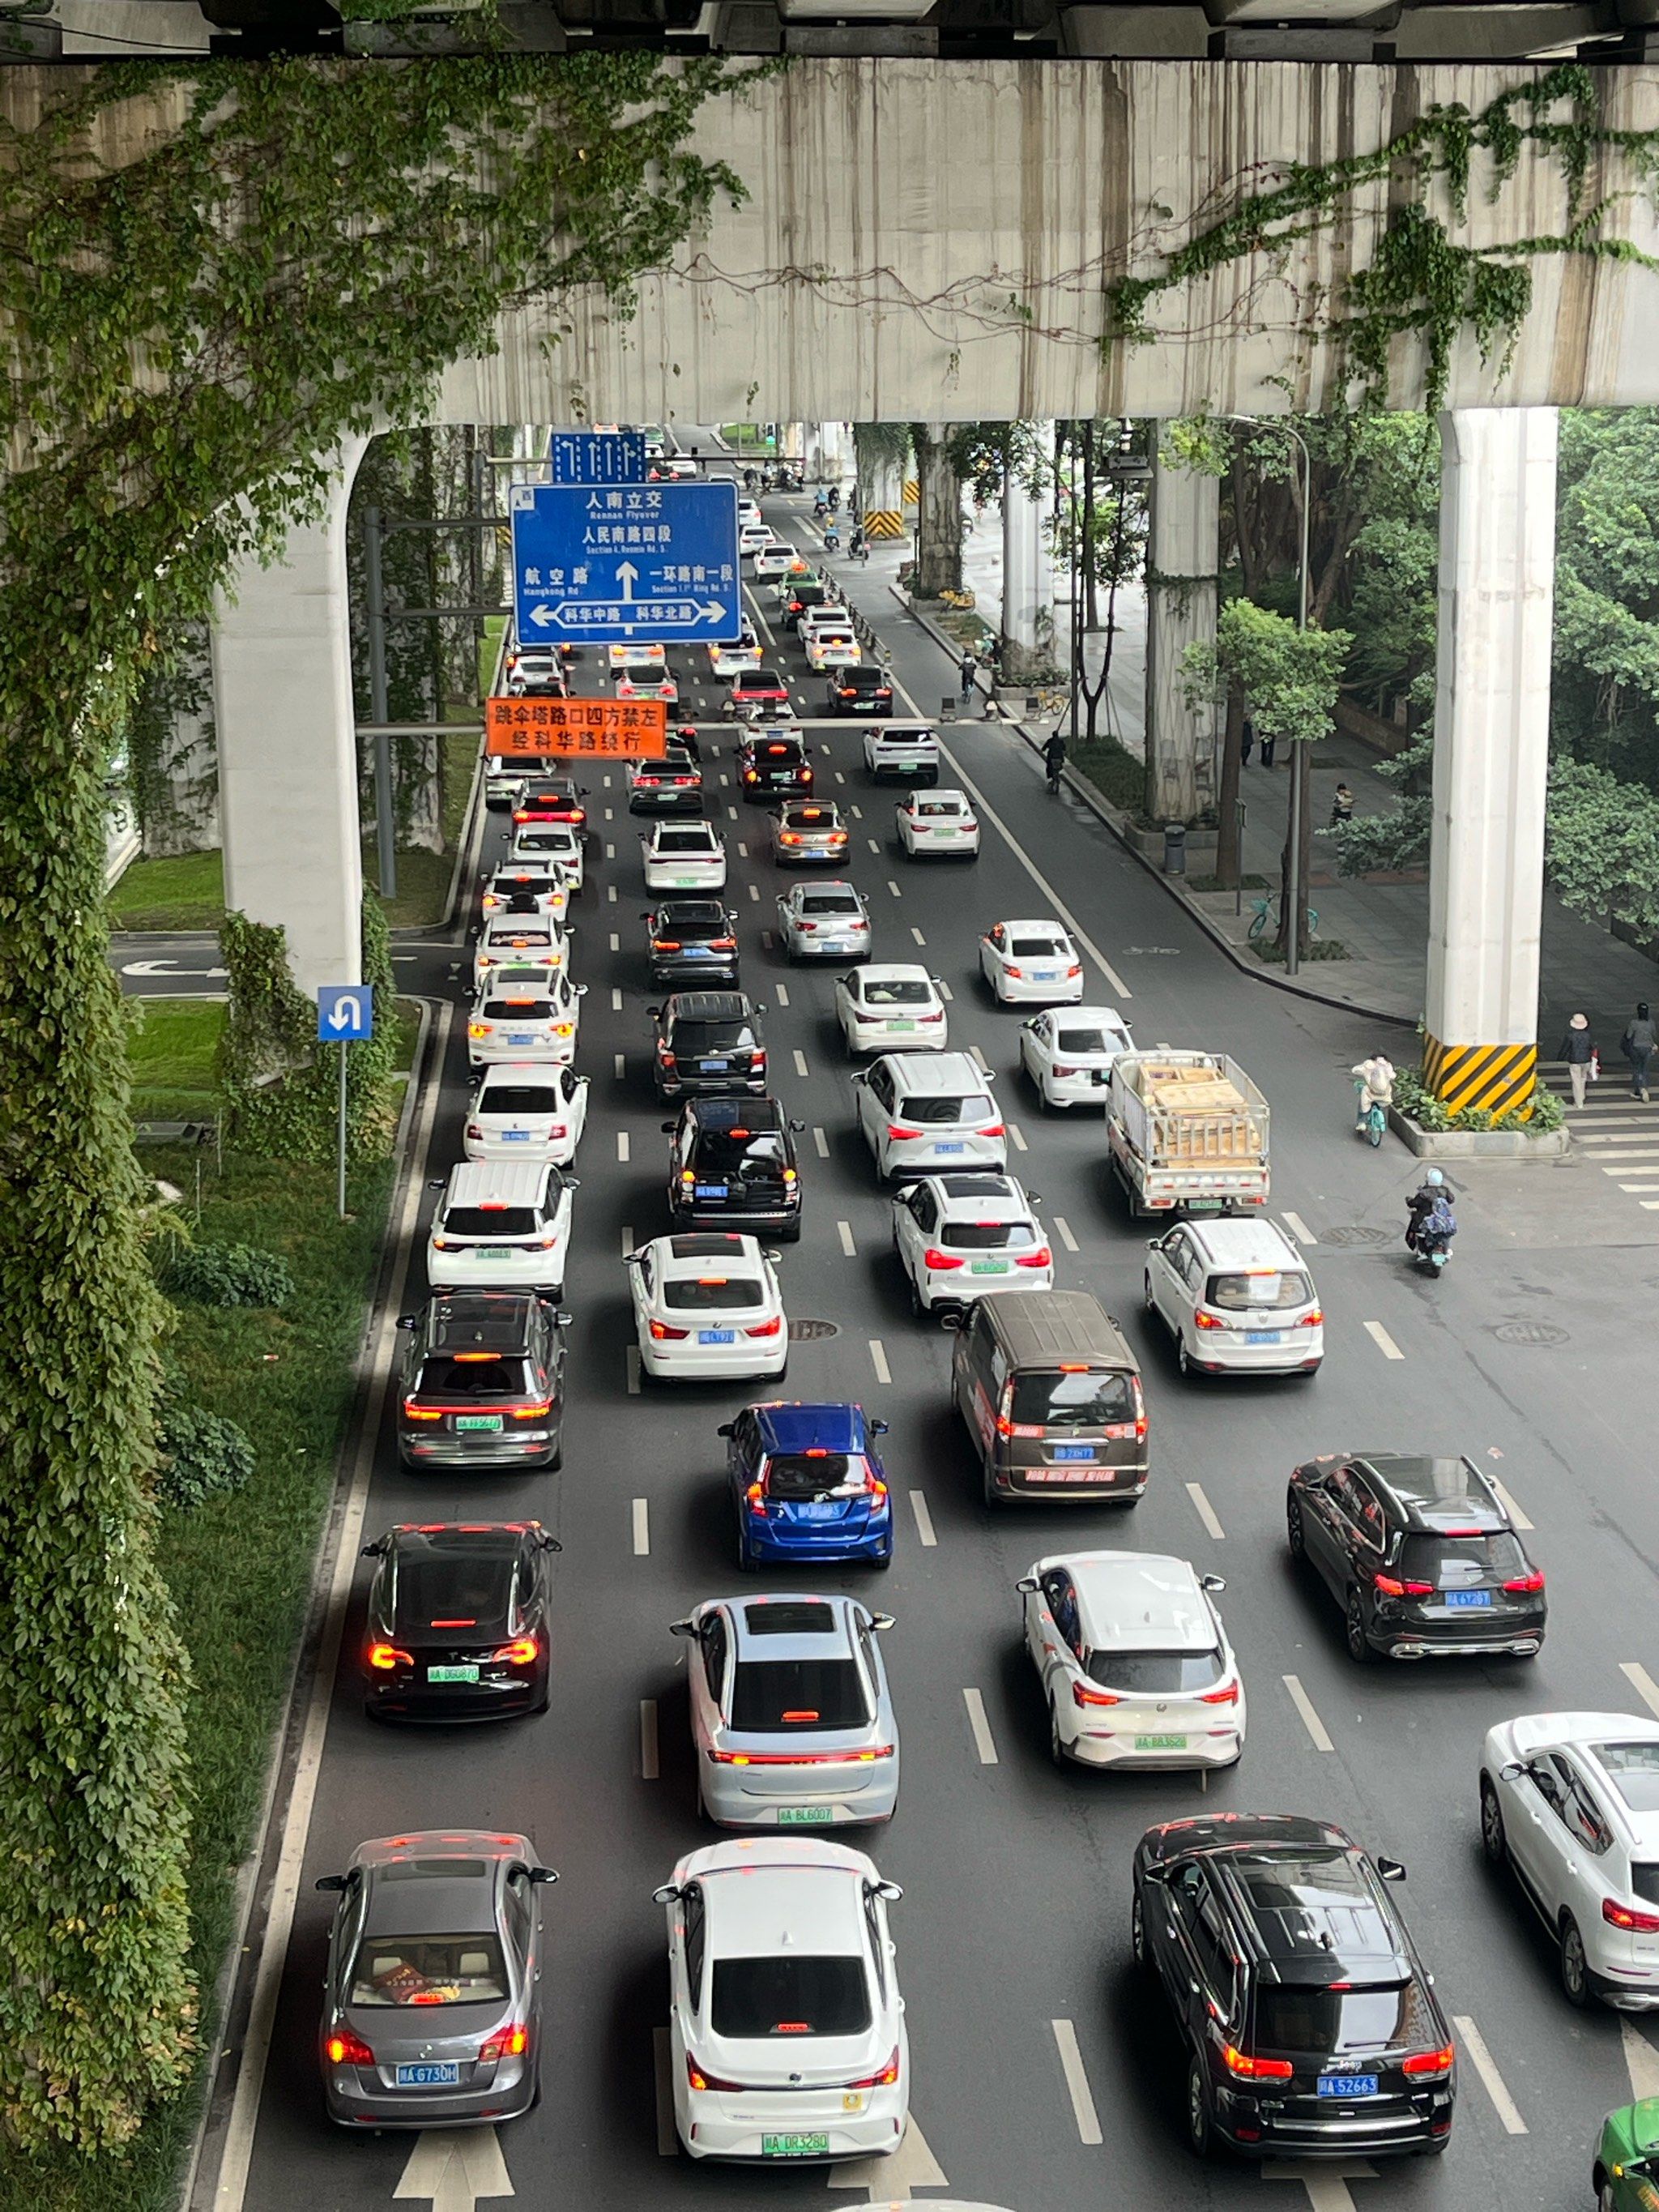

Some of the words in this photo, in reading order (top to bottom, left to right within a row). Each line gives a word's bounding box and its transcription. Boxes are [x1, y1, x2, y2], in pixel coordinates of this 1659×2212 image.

[586, 490, 663, 509] 人南立交
[582, 525, 672, 544] 人民南路四段
[525, 566, 588, 585] 航空路
[650, 564, 733, 583] 一环路南一段
[565, 607, 621, 622] 科华中路
[636, 604, 692, 621] 科华北路
[495, 705, 658, 727] 跳伞塔路口四方禁左
[512, 731, 641, 751] 经科华路绕行
